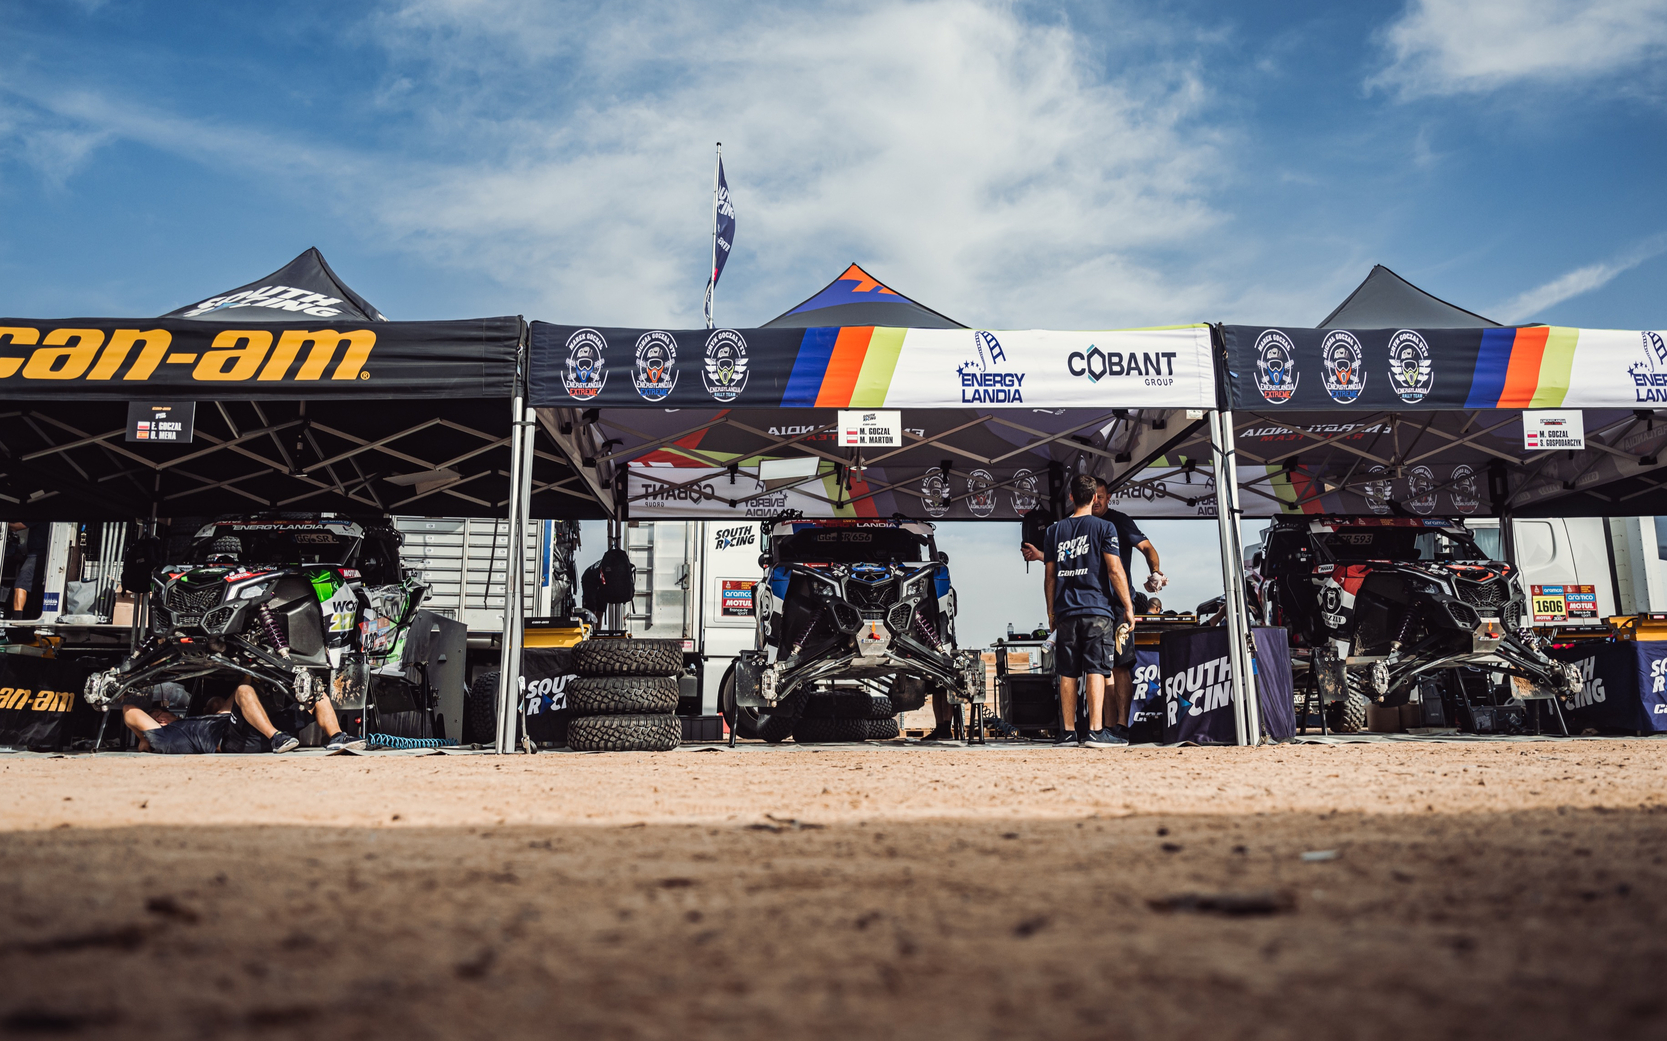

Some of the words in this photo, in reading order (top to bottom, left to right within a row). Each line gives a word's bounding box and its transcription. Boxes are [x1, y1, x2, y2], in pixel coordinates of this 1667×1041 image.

[1068, 346, 1177, 382] COBANT
[961, 373, 1026, 387] ENERGY
[1144, 378, 1174, 386] GROUP
[569, 388, 598, 396] EXTREME
[640, 388, 669, 396] EXTREME
[962, 389, 1024, 403] LANDIA
[1264, 390, 1292, 399] EXTREME
[1331, 390, 1359, 398] EXTREME
[859, 427, 867, 435] M.
[868, 427, 891, 435] GOCZAL
[1548, 430, 1568, 438] GOCZAL
[859, 436, 867, 444] M.
[869, 436, 893, 444] MARTON
[715, 525, 753, 540] SOUTH
[715, 534, 755, 550] RACING
[1057, 535, 1088, 553] SOUTH
[1535, 600, 1563, 613] 1606
[525, 673, 581, 699] SOUT
